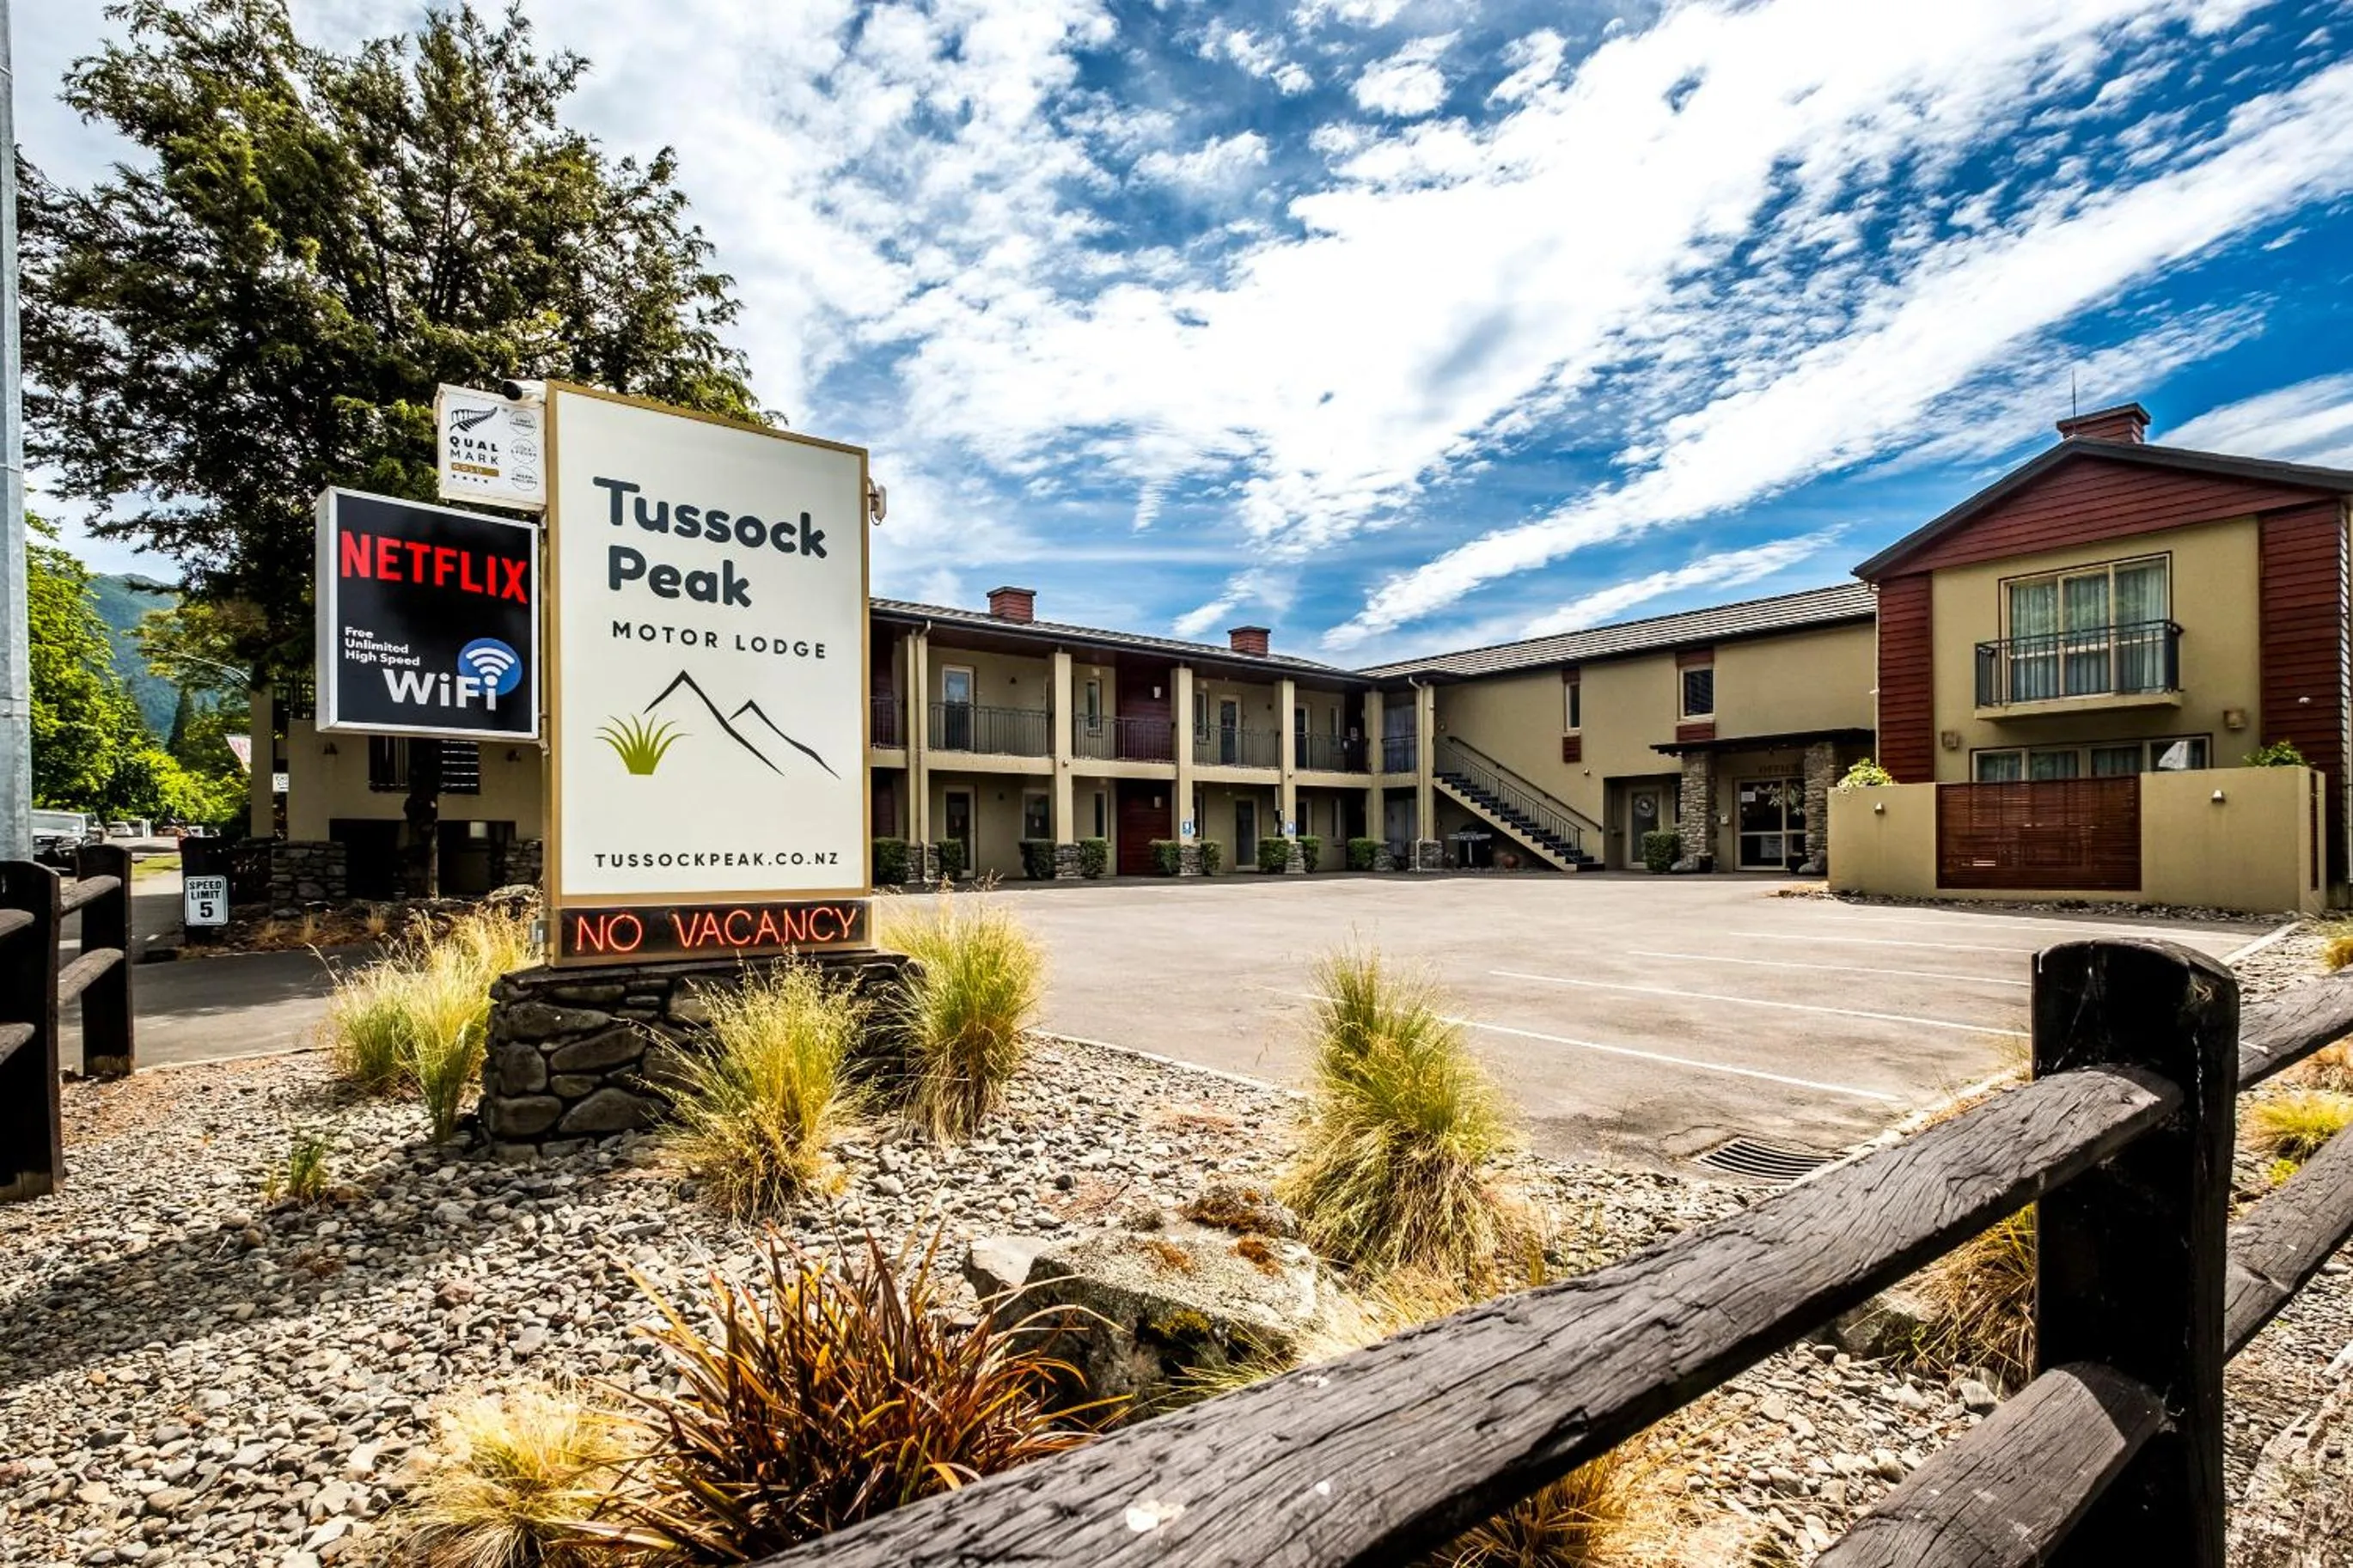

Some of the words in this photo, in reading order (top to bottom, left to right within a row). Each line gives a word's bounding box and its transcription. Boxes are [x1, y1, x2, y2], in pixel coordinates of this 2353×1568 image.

[449, 436, 498, 452] QUAL
[449, 448, 498, 465] MARK
[593, 476, 828, 558] Tussock
[341, 530, 528, 604] NETFLIX
[608, 545, 752, 607] Peak
[345, 626, 374, 638] Free
[612, 620, 718, 648] MOTOR
[736, 635, 826, 659] LODGE
[345, 638, 409, 654] Unlimited
[345, 649, 377, 663] High
[380, 653, 420, 666] Speed
[382, 668, 497, 711] WiFi
[595, 852, 839, 868] TUSSOCKPEAK.CO.NZ
[189, 881, 222, 890] SPEED
[191, 890, 220, 900] LIMIT
[200, 901, 214, 918] 5
[577, 913, 643, 952] NO
[672, 906, 857, 949] VACANCY
